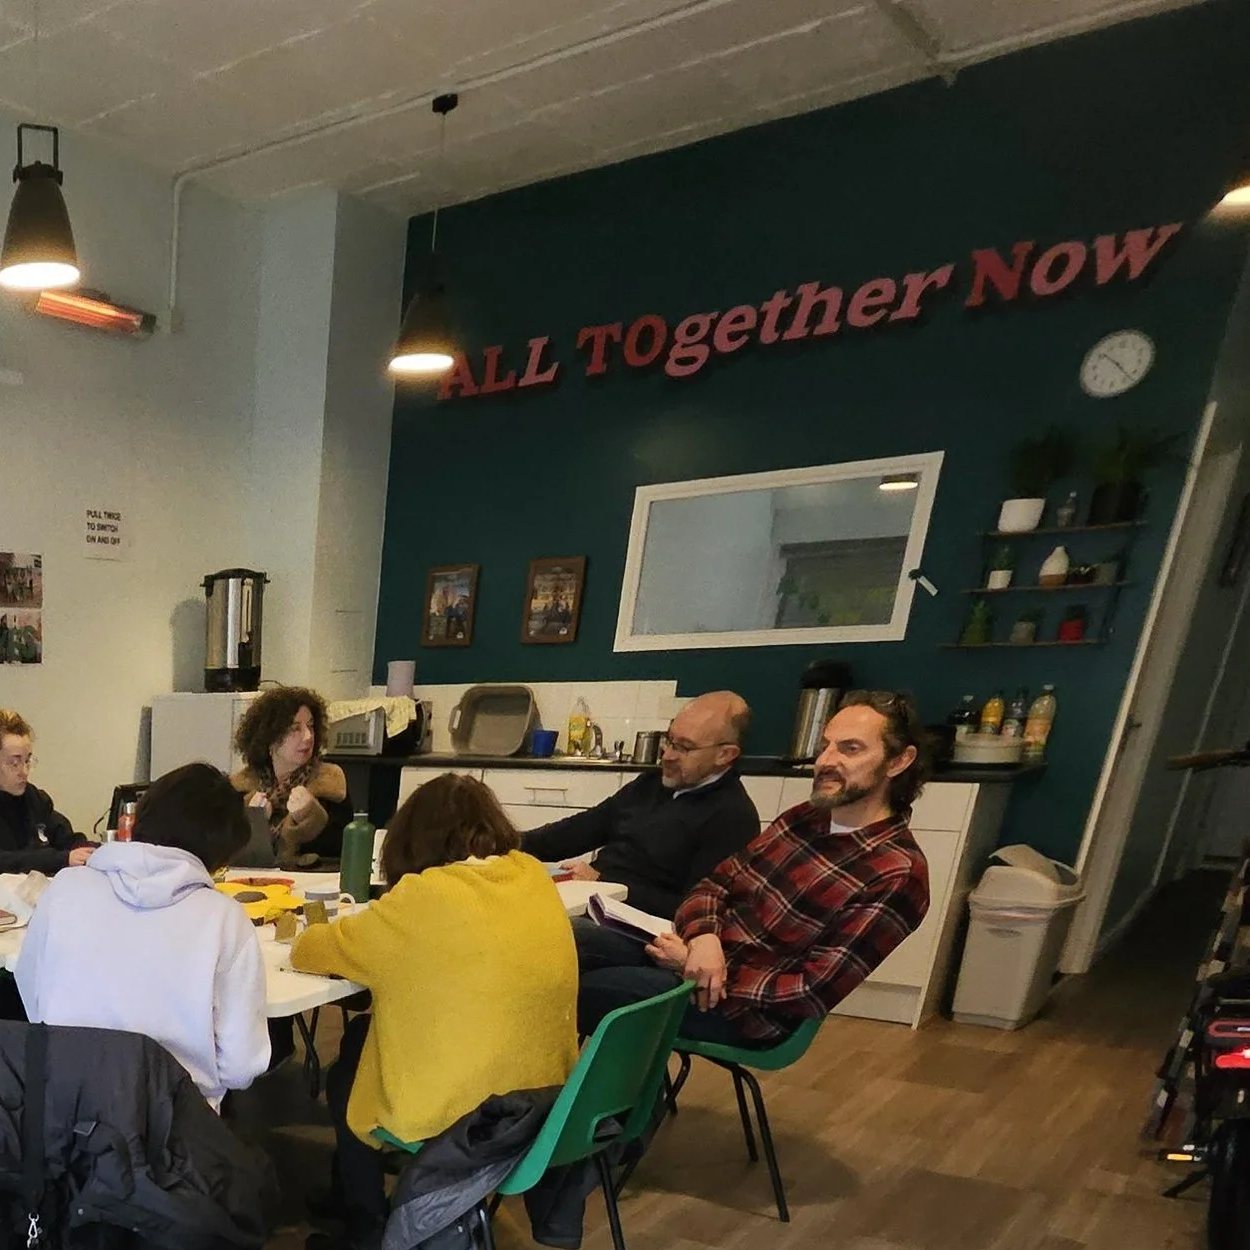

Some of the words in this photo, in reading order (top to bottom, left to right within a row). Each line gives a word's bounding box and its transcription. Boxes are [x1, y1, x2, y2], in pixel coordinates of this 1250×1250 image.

[436, 335, 560, 400] ALL
[86, 509, 102, 519] PULL
[103, 511, 121, 521] TWICE
[86, 522, 95, 531] TO
[96, 523, 119, 532] SWITCH
[86, 535, 96, 543] ON
[97, 536, 109, 544] AND
[110, 536, 121, 545] OFF
